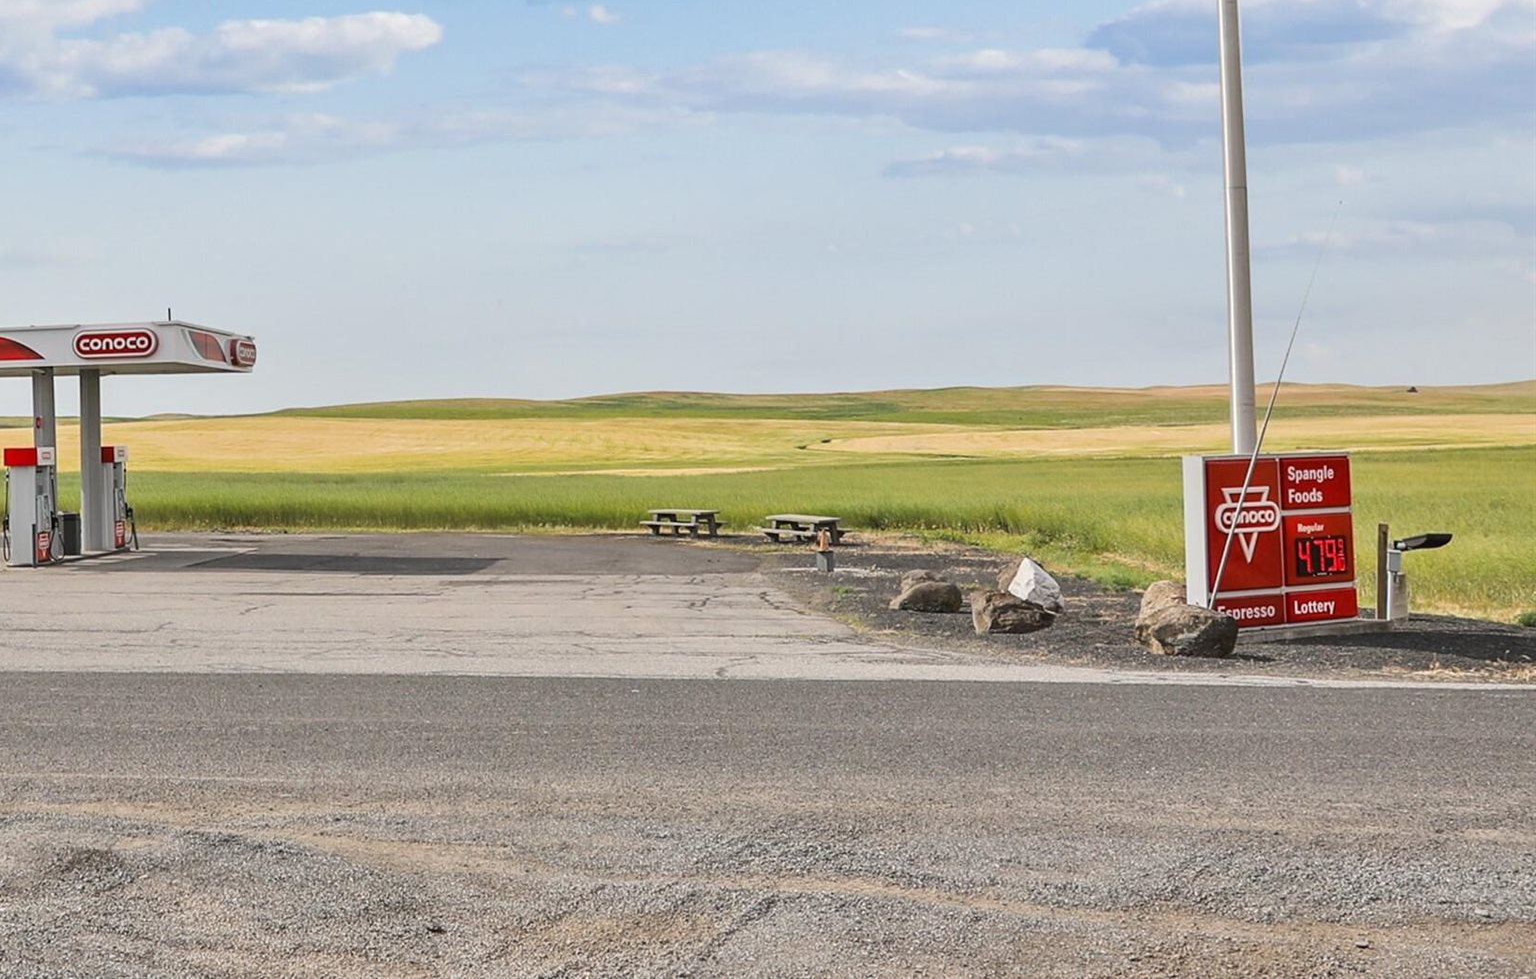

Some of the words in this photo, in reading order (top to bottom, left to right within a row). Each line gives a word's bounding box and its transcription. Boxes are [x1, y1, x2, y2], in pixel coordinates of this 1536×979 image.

[79, 336, 149, 351] conoco
[1287, 465, 1334, 484] Spangle
[1288, 487, 1323, 503] Foods
[1297, 522, 1324, 534] Regular
[1294, 600, 1335, 615] Lottery
